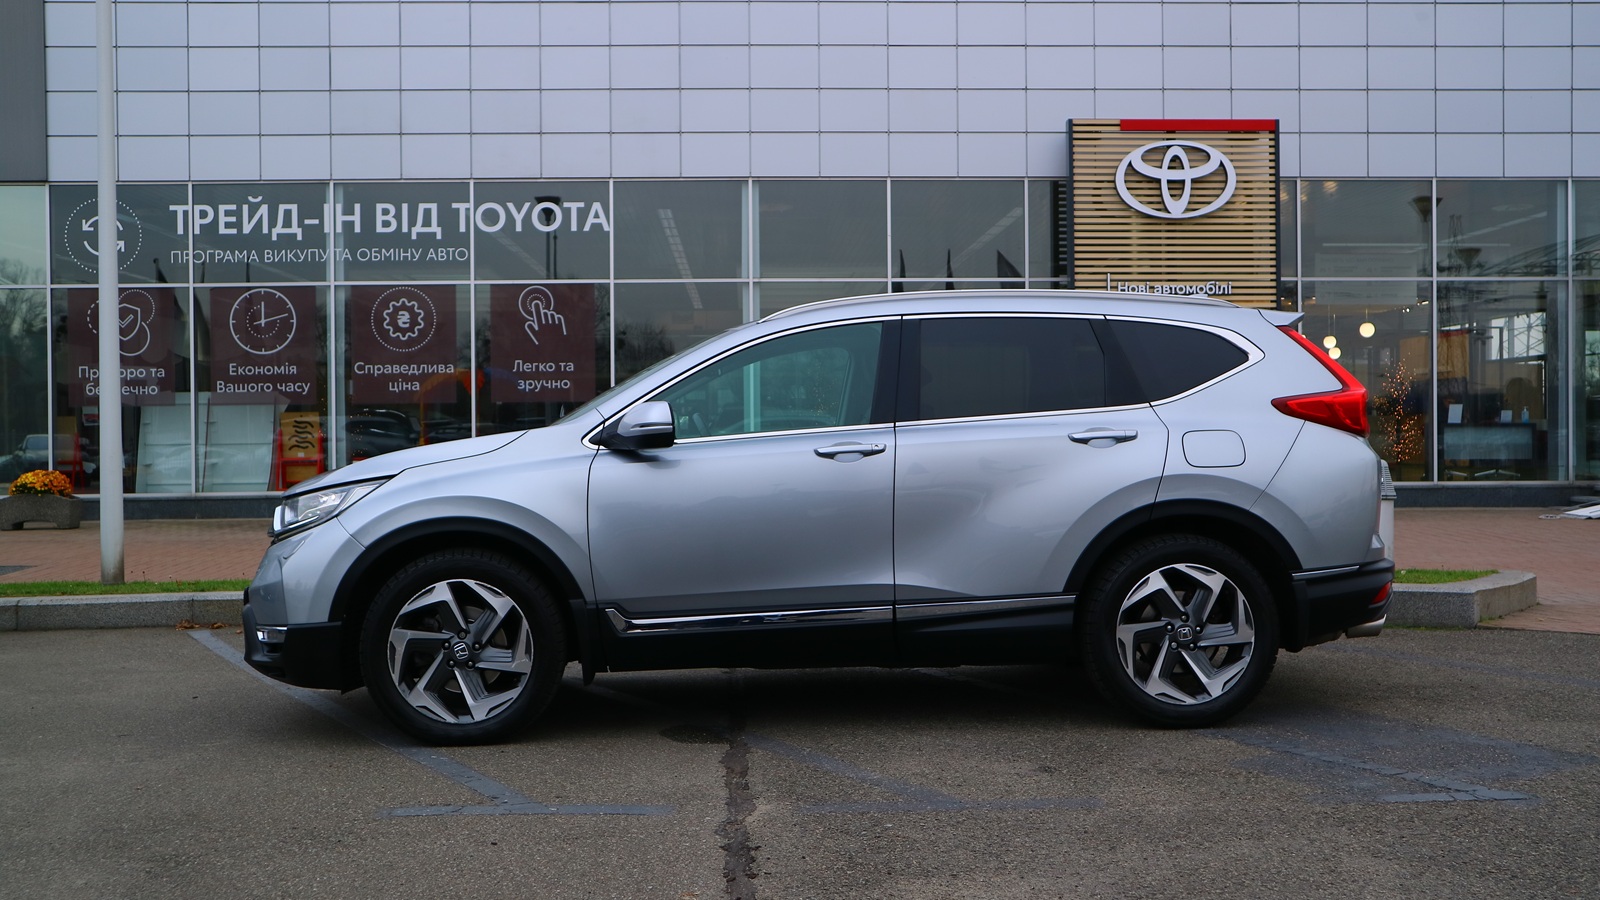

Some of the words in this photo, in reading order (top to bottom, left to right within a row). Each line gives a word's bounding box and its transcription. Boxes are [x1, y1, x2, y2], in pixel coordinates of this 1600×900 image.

[168, 195, 361, 241] ТРЕЙД-ІН
[375, 202, 442, 240] ВІД
[451, 201, 610, 233] TOYOTA
[170, 249, 259, 264] ПРОГРАМА
[264, 248, 330, 263] ВИКУПУ
[333, 247, 352, 262] ТА
[356, 247, 423, 262] ОБМІНУ
[426, 247, 469, 262] АВТО
[1117, 281, 1150, 293] Нові
[1153, 280, 1232, 295] автомобілі
[229, 362, 297, 375] Економія
[354, 361, 454, 377] Справедлива
[512, 359, 555, 372] Легко
[558, 362, 574, 372] та
[78, 366, 146, 381] Проро
[149, 367, 165, 378] та
[216, 380, 273, 393] Вашого
[277, 382, 310, 395] часу
[389, 378, 420, 393] ціна
[517, 379, 571, 392] зручно
